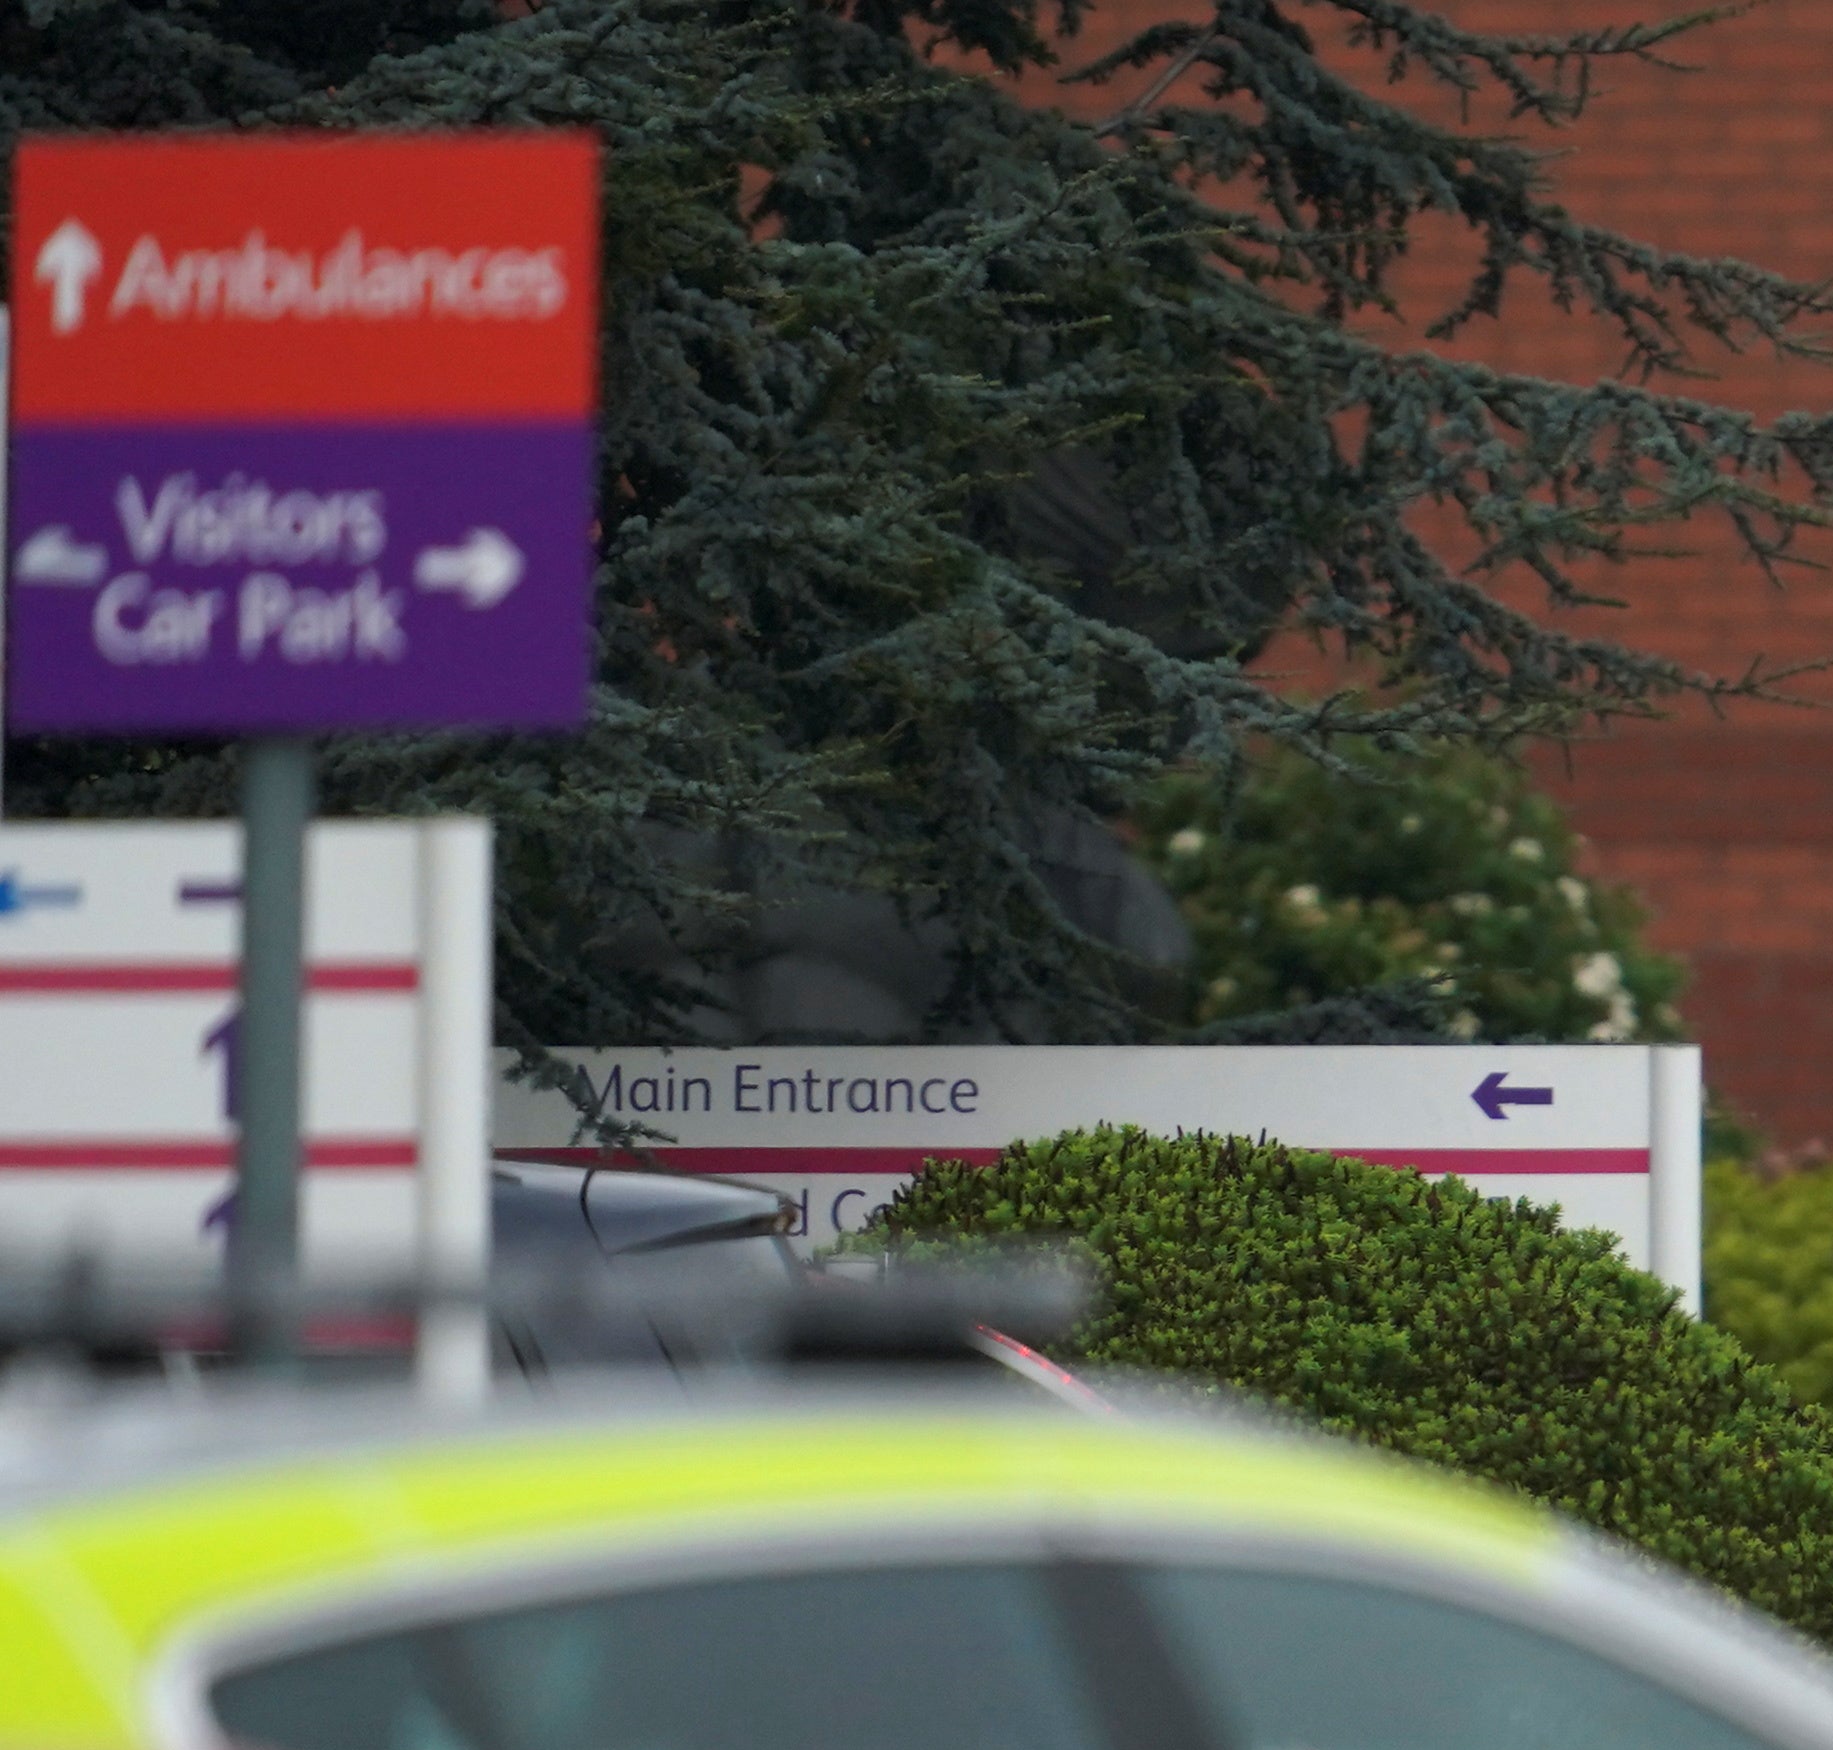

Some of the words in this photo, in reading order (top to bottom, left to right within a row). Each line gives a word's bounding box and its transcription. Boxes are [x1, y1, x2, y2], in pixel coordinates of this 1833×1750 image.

[107, 229, 568, 322] Ambulances
[116, 471, 388, 566] Visitors
[92, 571, 226, 665] Car
[237, 567, 408, 663] Park
[577, 1063, 711, 1113] Main
[734, 1064, 980, 1114] Entrance
